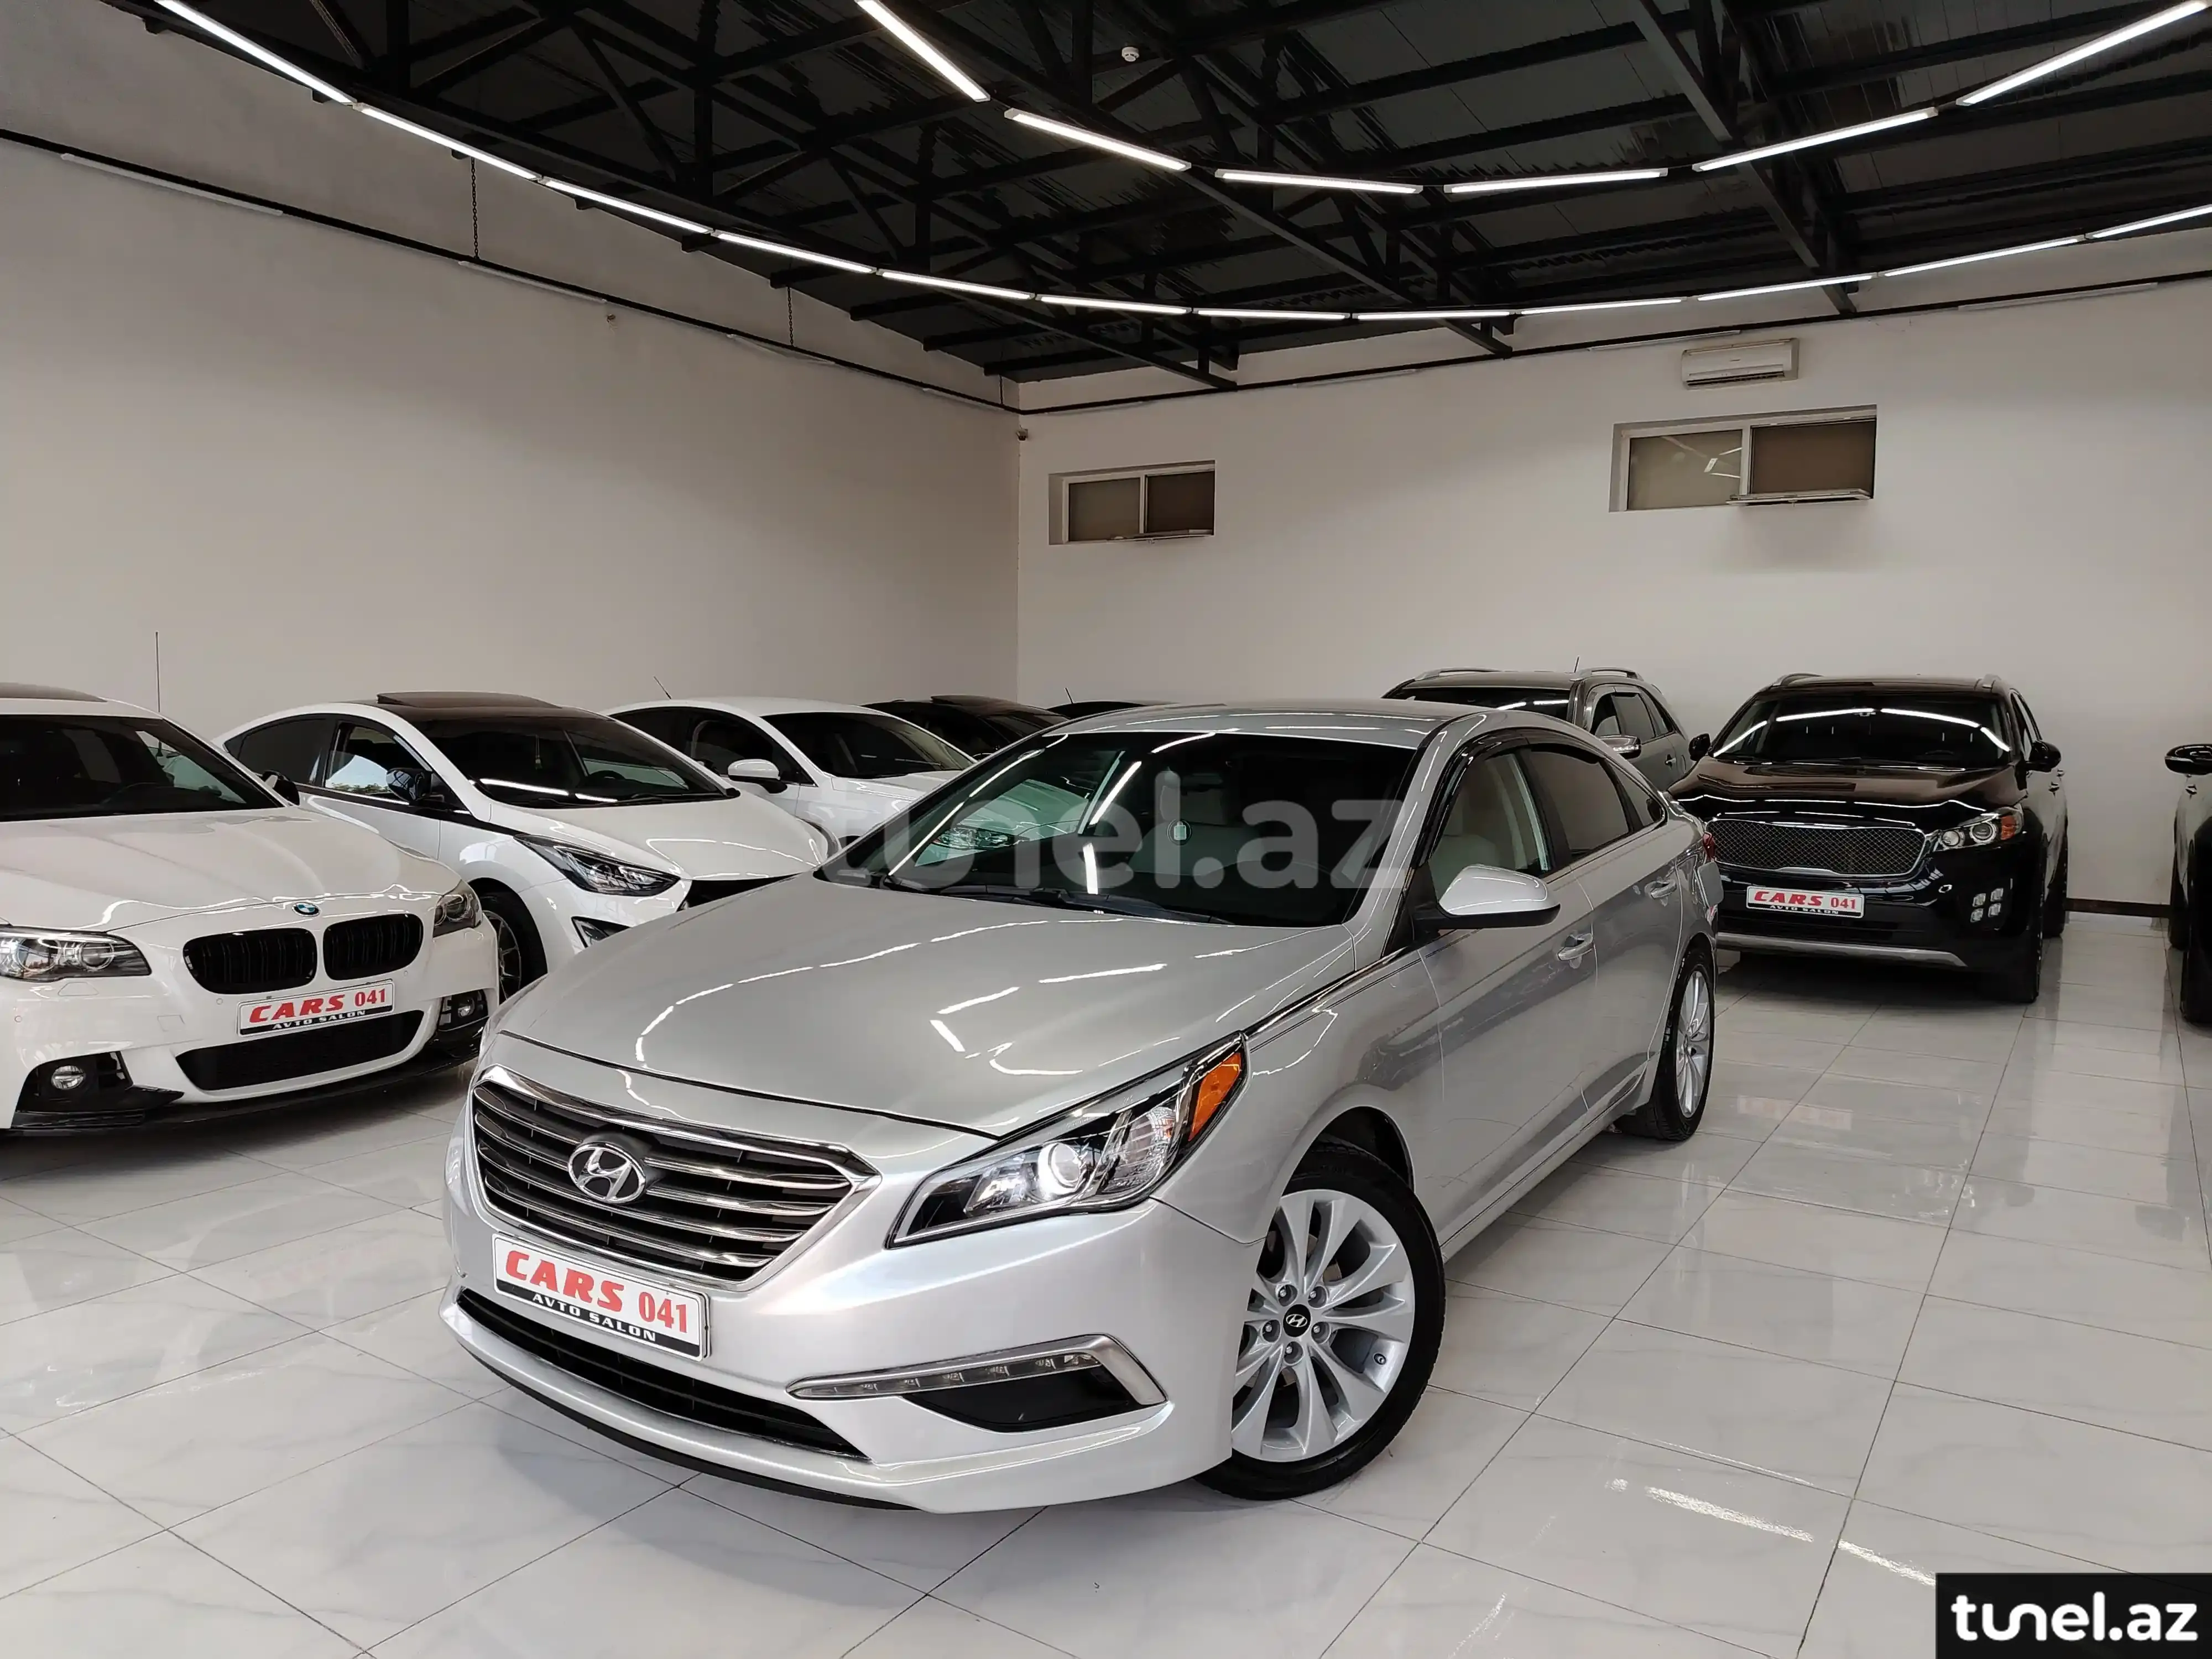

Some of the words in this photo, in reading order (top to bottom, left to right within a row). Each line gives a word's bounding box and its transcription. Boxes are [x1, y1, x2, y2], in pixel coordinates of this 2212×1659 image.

[1754, 891, 1823, 906] CARS
[1830, 897, 1856, 909] 041
[249, 994, 346, 1023] CARS
[354, 988, 385, 1006] 041
[272, 1019, 313, 1030] AVTO
[319, 1010, 366, 1022] SALON
[505, 1250, 624, 1312] CARS
[638, 1291, 687, 1334] 041
[532, 1293, 581, 1318] AVTO
[589, 1312, 656, 1342] SALON
